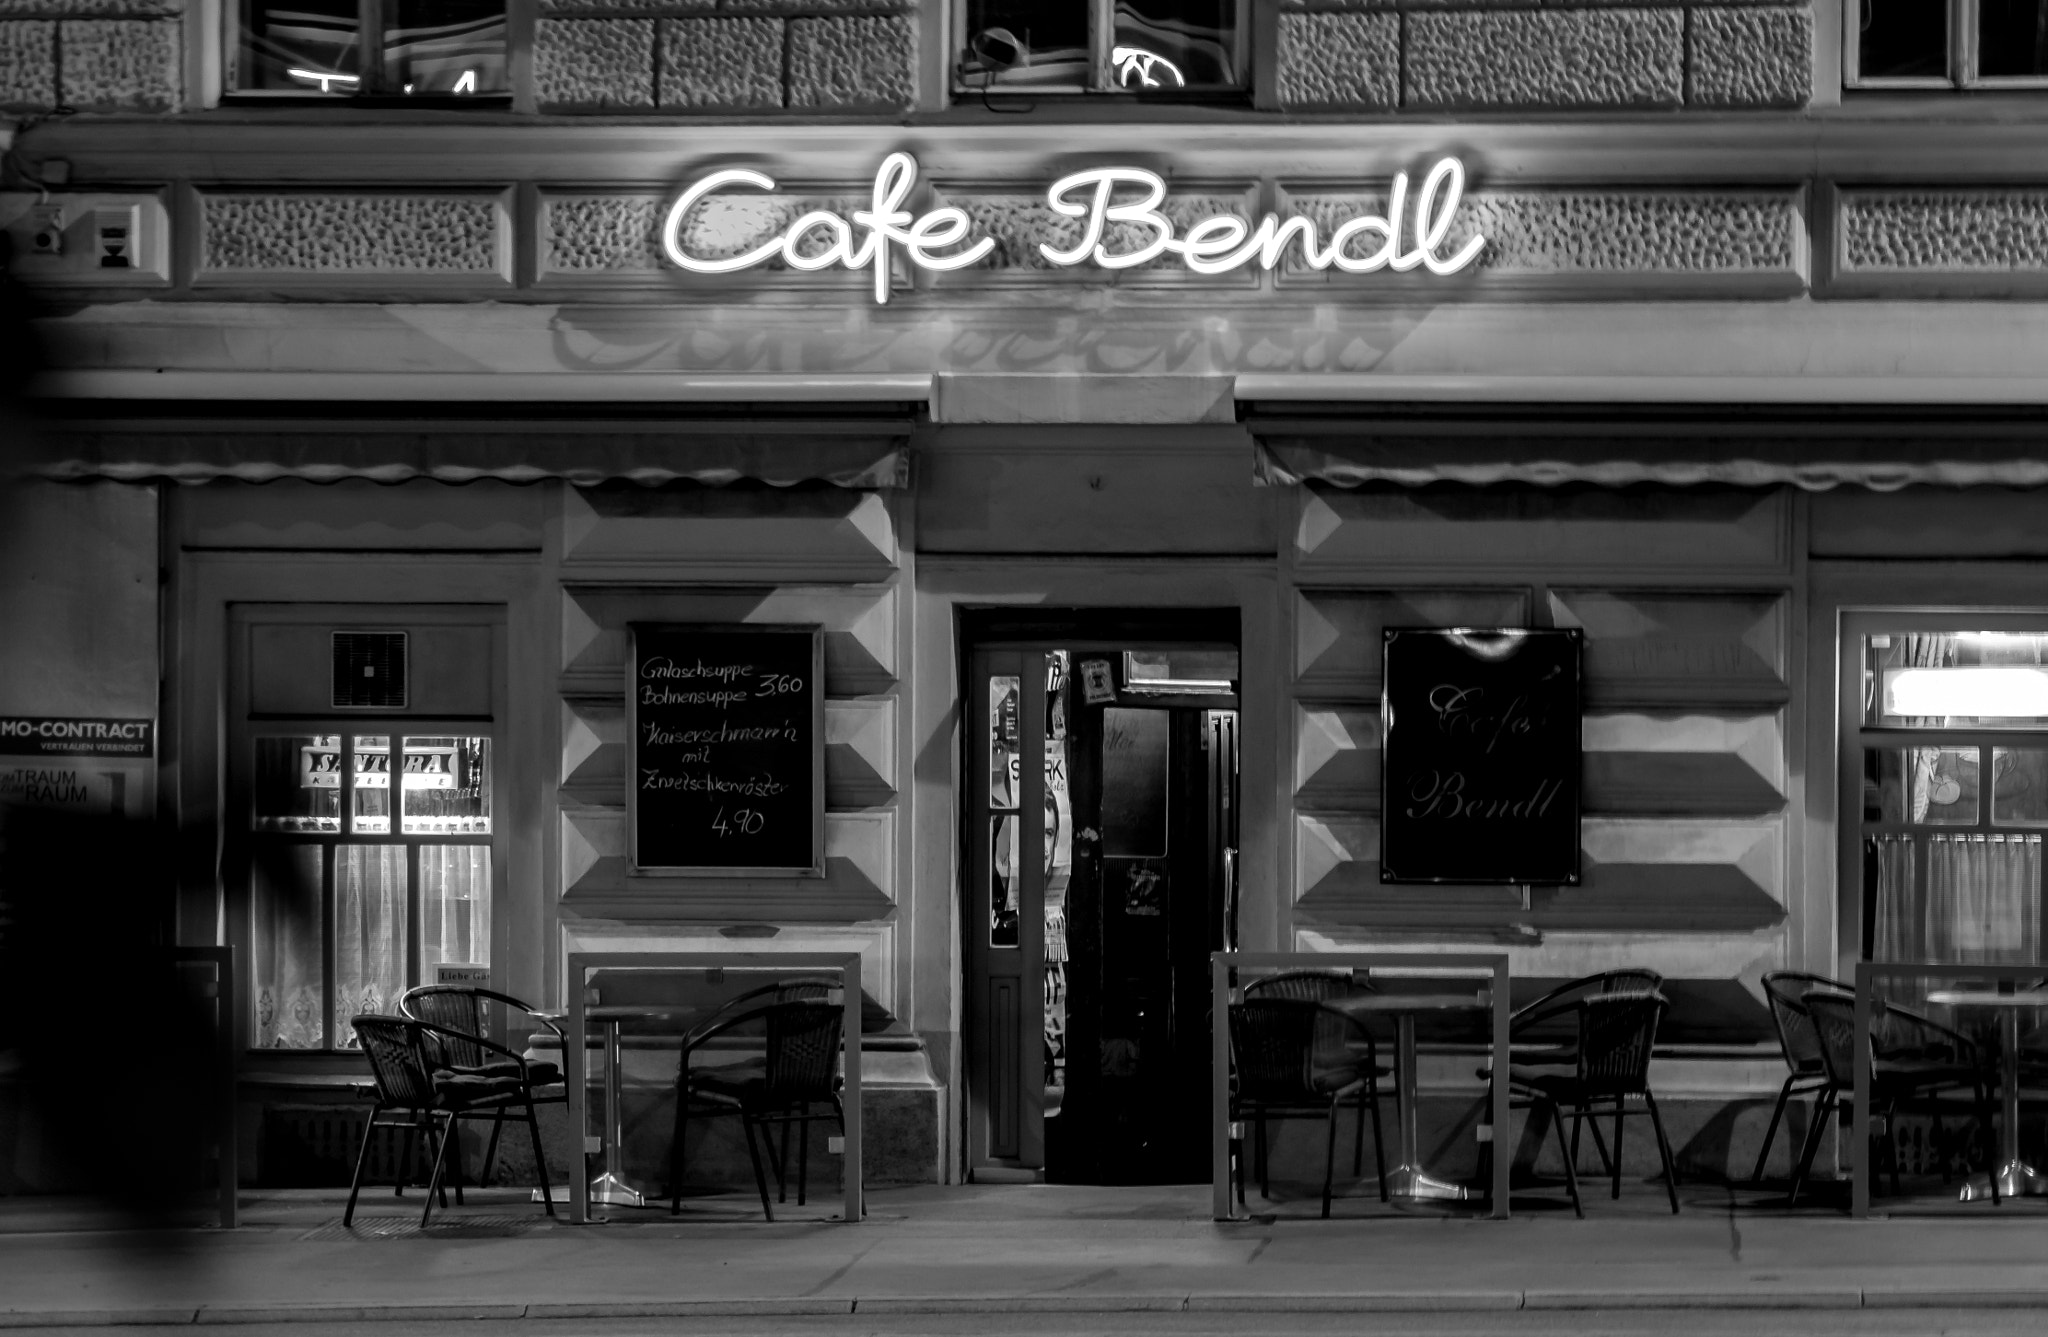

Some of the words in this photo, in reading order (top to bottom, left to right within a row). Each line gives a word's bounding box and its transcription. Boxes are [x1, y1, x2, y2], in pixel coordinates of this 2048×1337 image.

[663, 151, 995, 305] Cafe
[1039, 156, 1487, 276] Bendl
[640, 684, 748, 710] Bohnensuppe
[40, 742, 94, 751] VERTRAUEN
[681, 745, 710, 763] mit
[14, 769, 76, 785] TRAUM
[25, 785, 87, 802] RAUM
[1406, 769, 1563, 818] Bendl
[441, 972, 469, 981] Liebe
